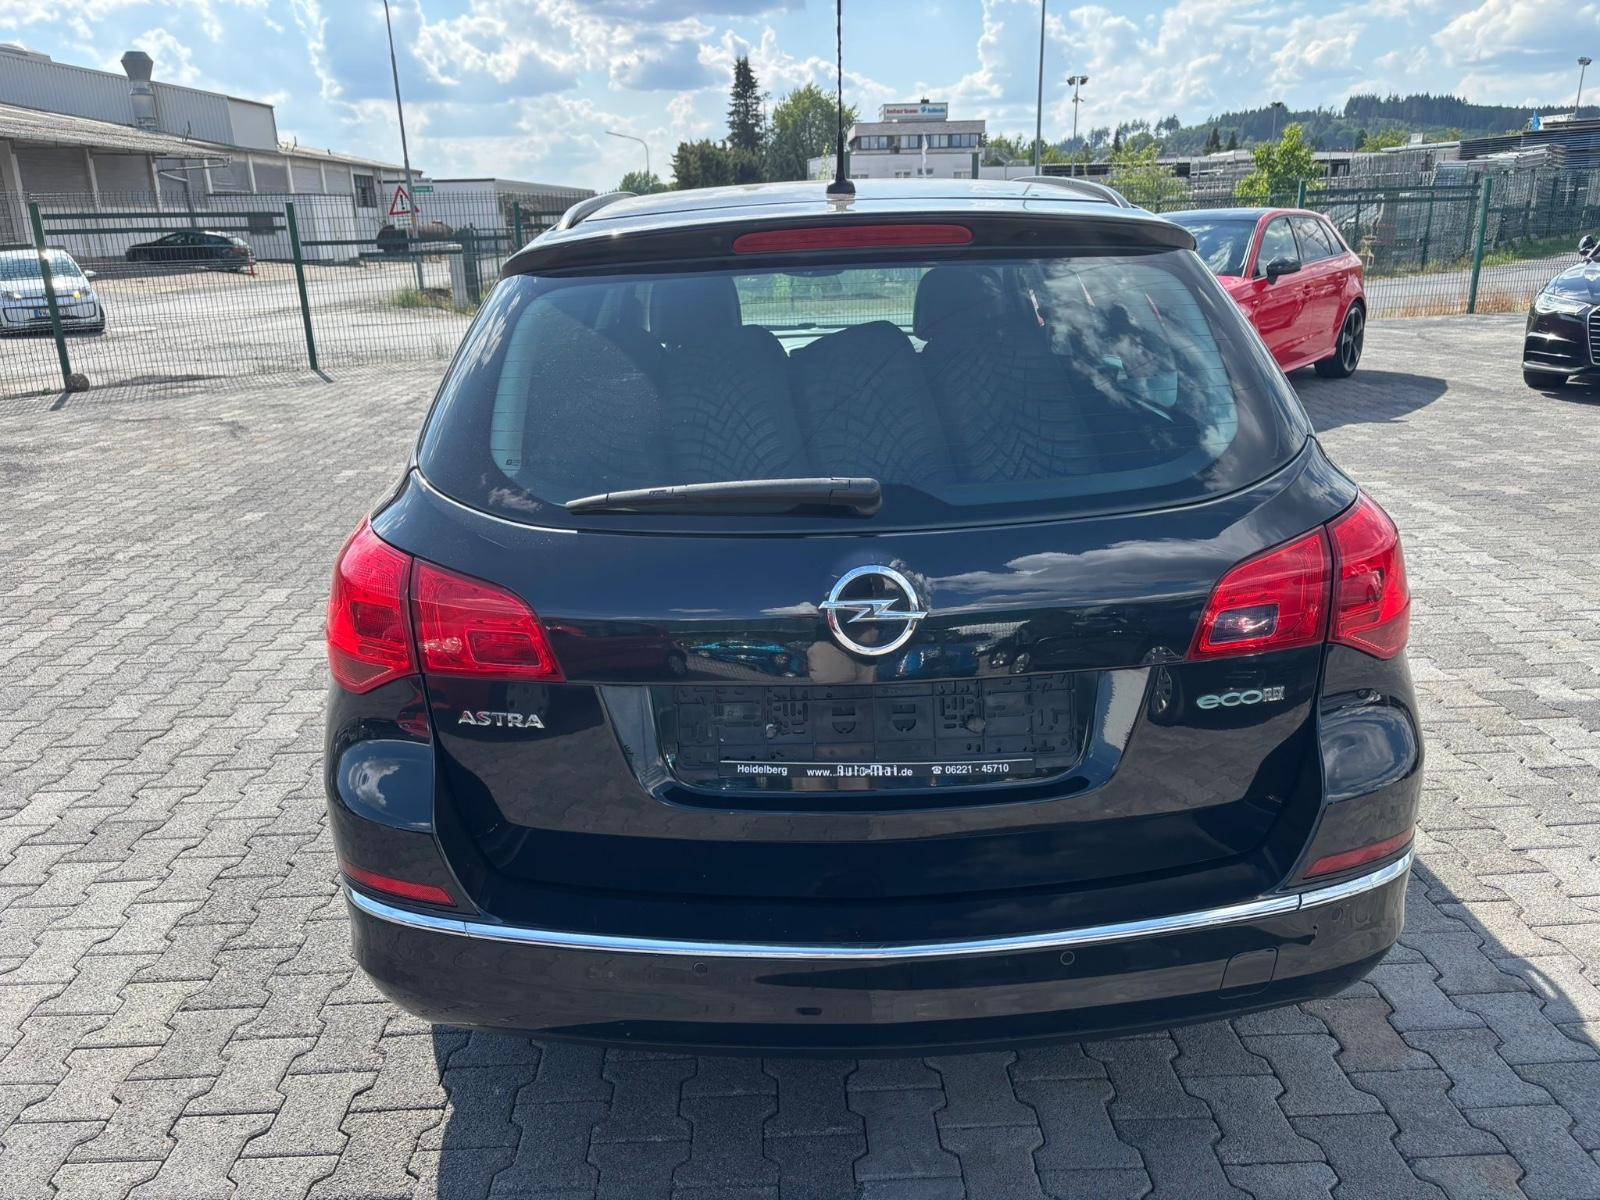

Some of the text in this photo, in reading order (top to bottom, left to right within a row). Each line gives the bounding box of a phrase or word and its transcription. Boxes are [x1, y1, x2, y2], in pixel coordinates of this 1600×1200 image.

[458, 710, 545, 728] ASTRA
[737, 764, 788, 776] Heidelberg
[945, 765, 972, 774] 06221
[981, 764, 1009, 773] 45710
